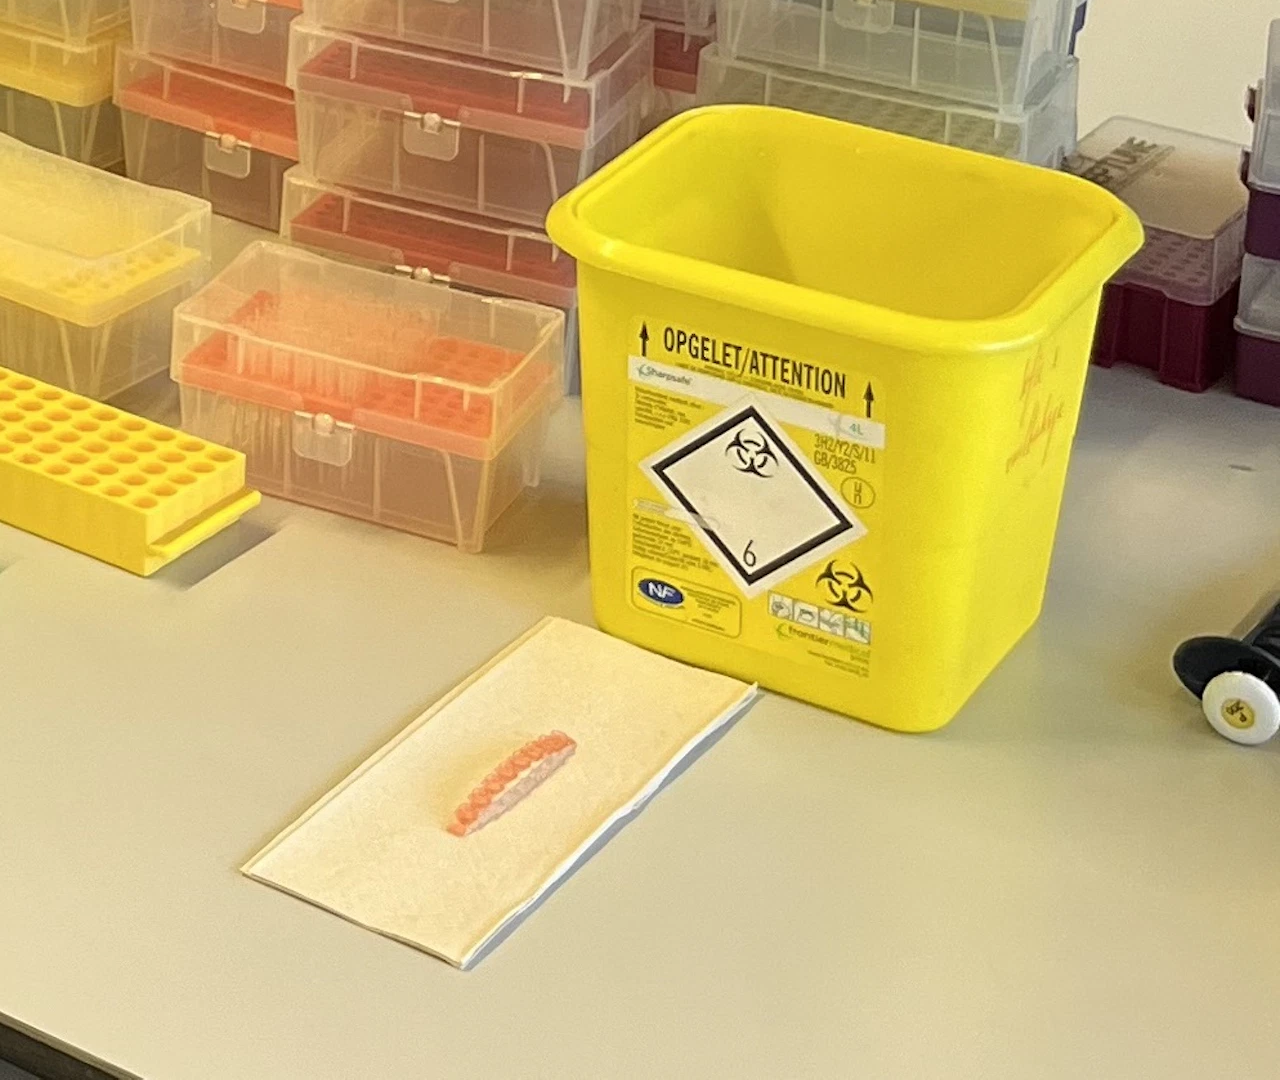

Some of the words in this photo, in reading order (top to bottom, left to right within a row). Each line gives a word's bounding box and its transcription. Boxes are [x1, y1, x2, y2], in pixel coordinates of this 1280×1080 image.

[664, 326, 846, 399] OPGELET/ATTENTION
[743, 539, 757, 567] 6
[647, 581, 678, 600] NF
